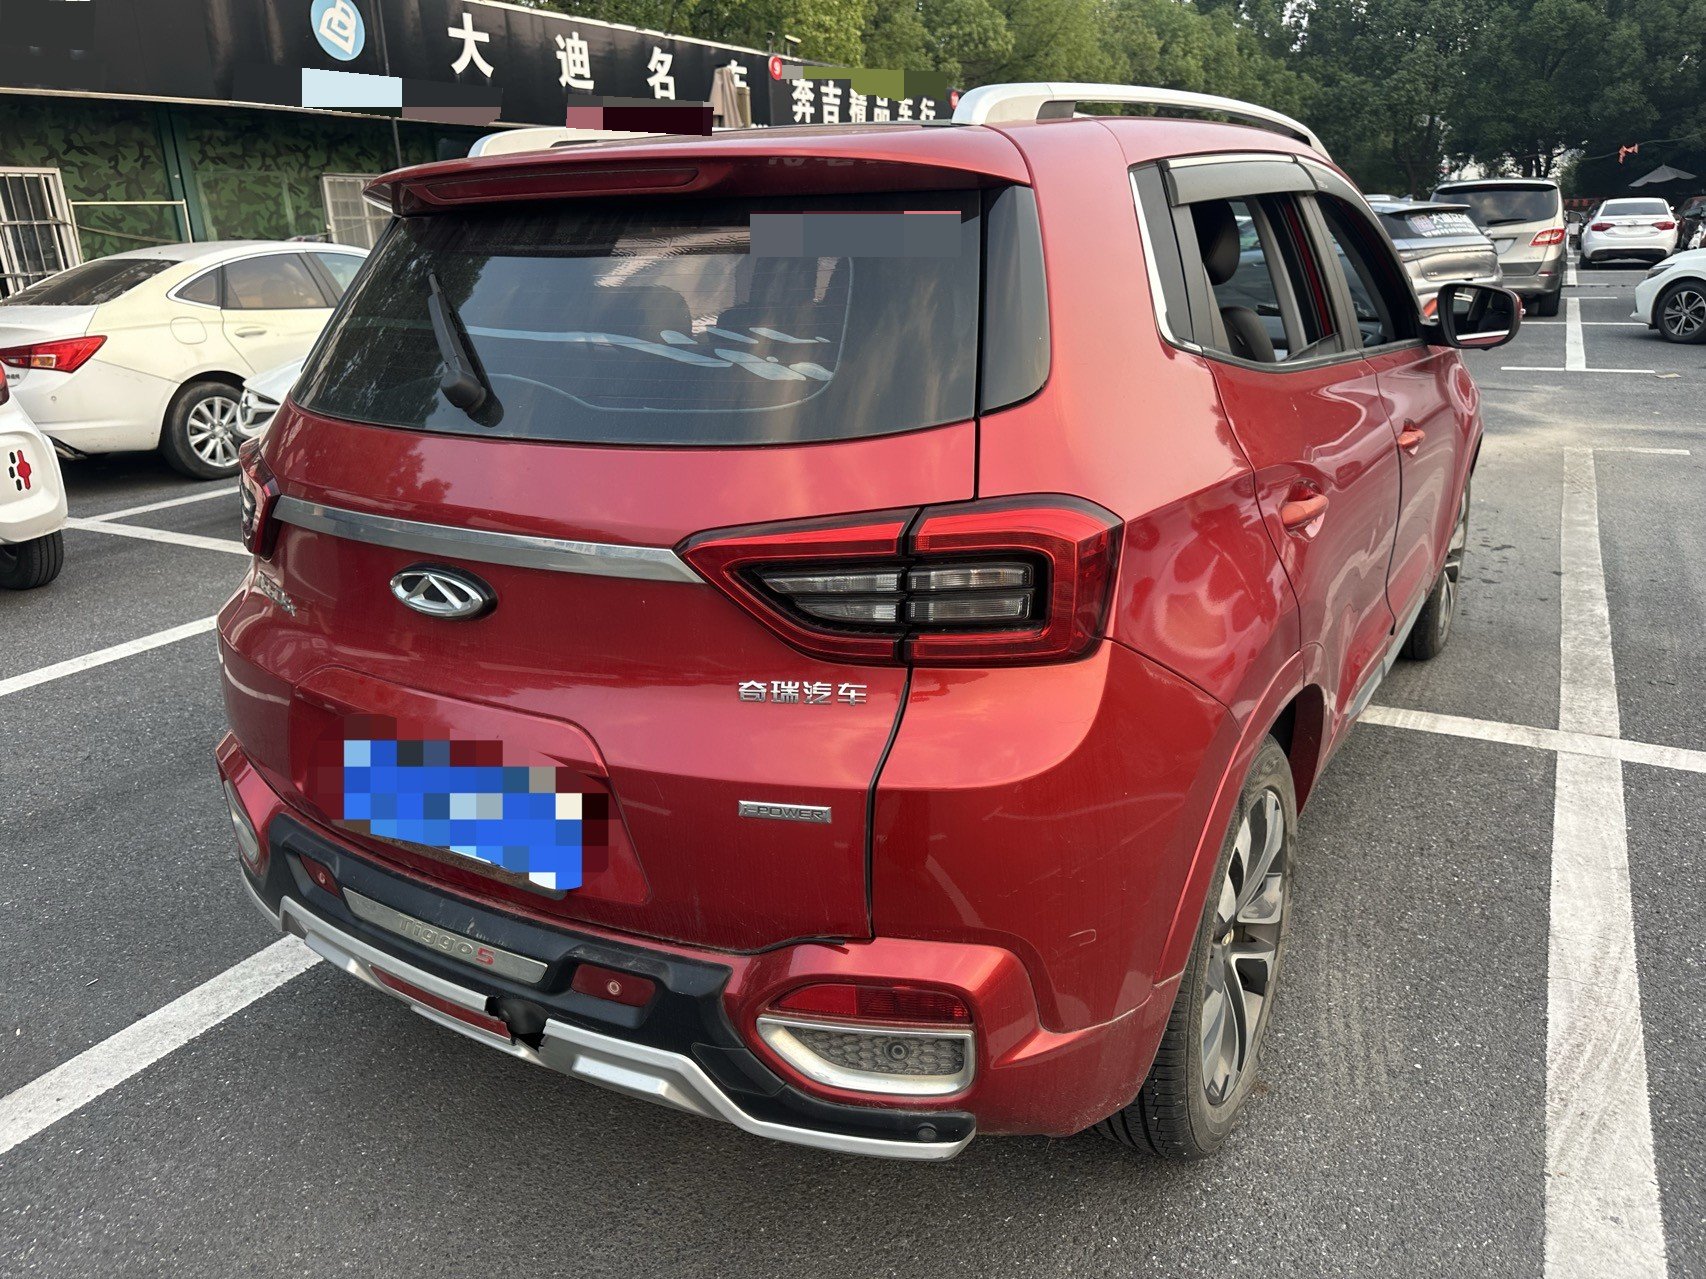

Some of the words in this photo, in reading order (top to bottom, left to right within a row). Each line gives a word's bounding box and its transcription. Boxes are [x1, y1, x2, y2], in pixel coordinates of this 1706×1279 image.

[792, 78, 936, 124] 奔吉精品车行
[738, 680, 868, 706] 奇瑞汽车
